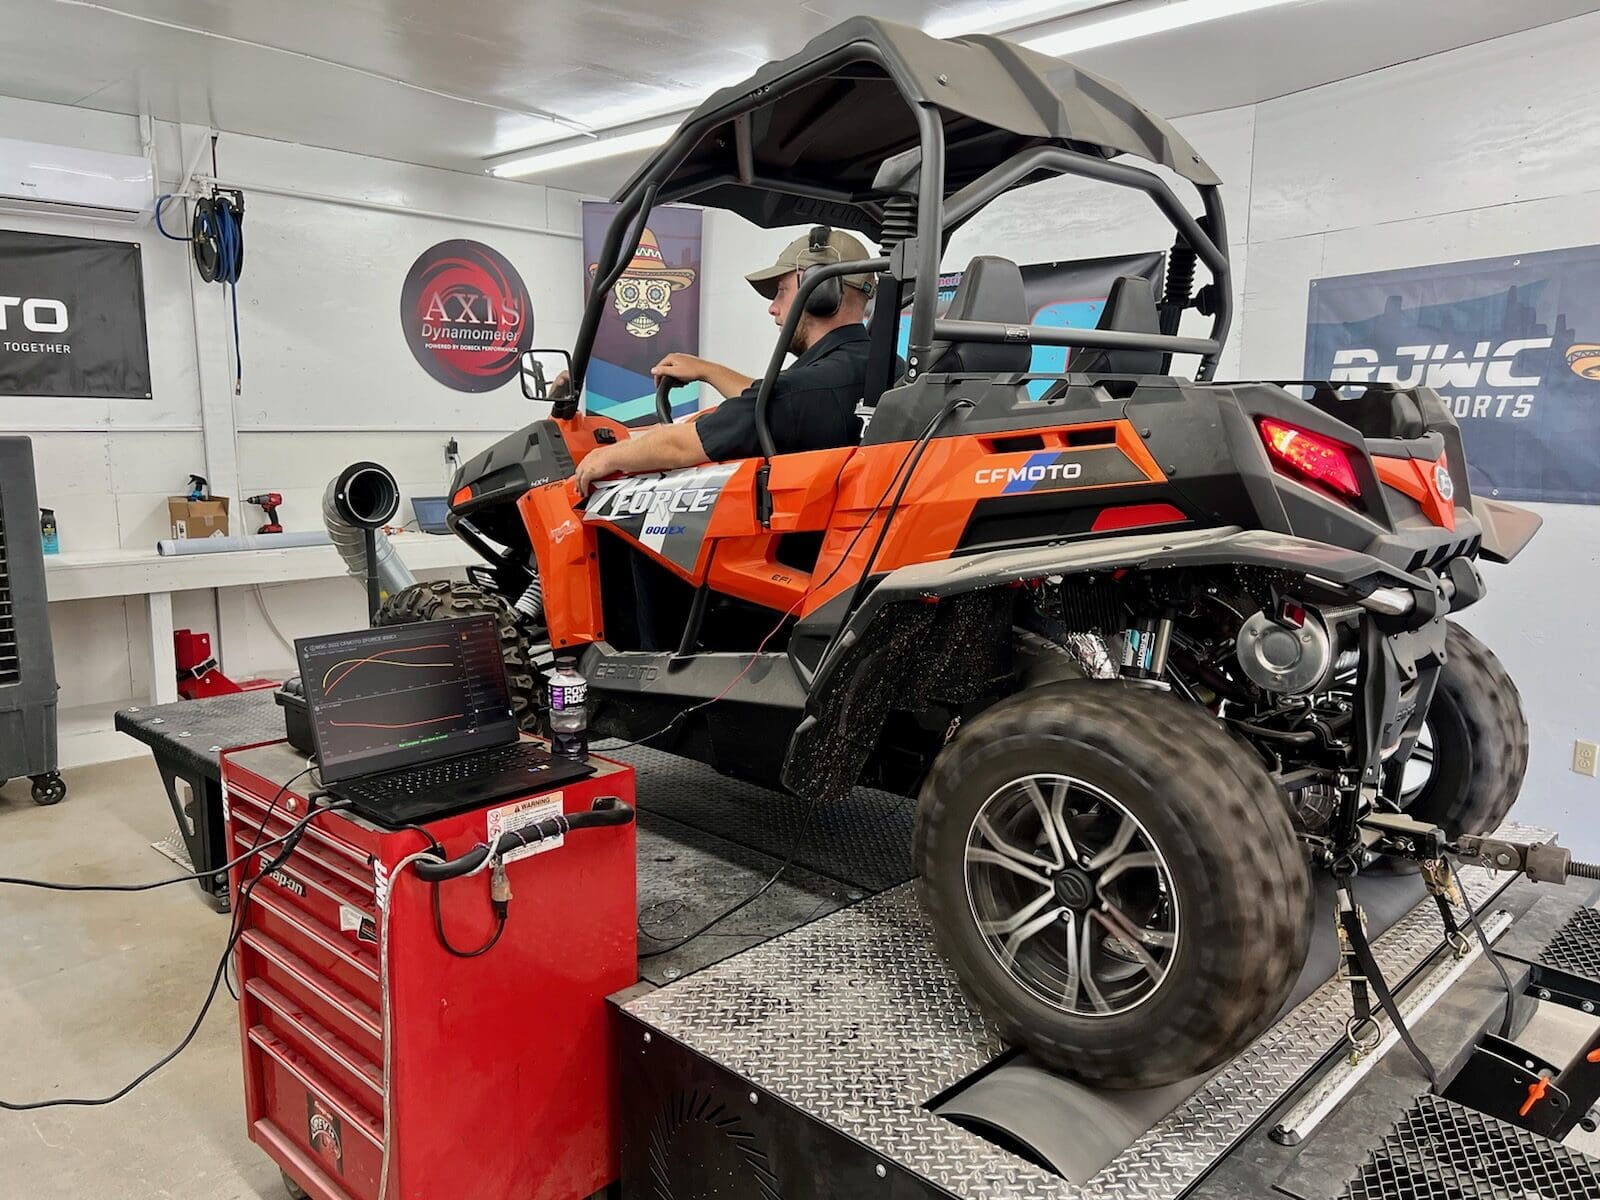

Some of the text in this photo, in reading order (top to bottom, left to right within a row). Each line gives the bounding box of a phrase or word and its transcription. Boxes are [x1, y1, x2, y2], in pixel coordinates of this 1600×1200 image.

[423, 292, 520, 326] AXIS
[422, 324, 519, 341] Dynamometer
[4, 342, 71, 354] TOGETHER
[425, 343, 452, 351] POWERED
[1330, 338, 1553, 392] RJWC
[974, 463, 1082, 484] CFMOTO
[645, 526, 686, 535] 800EX
[771, 574, 792, 584] EFI
[521, 797, 551, 809] WARNING
